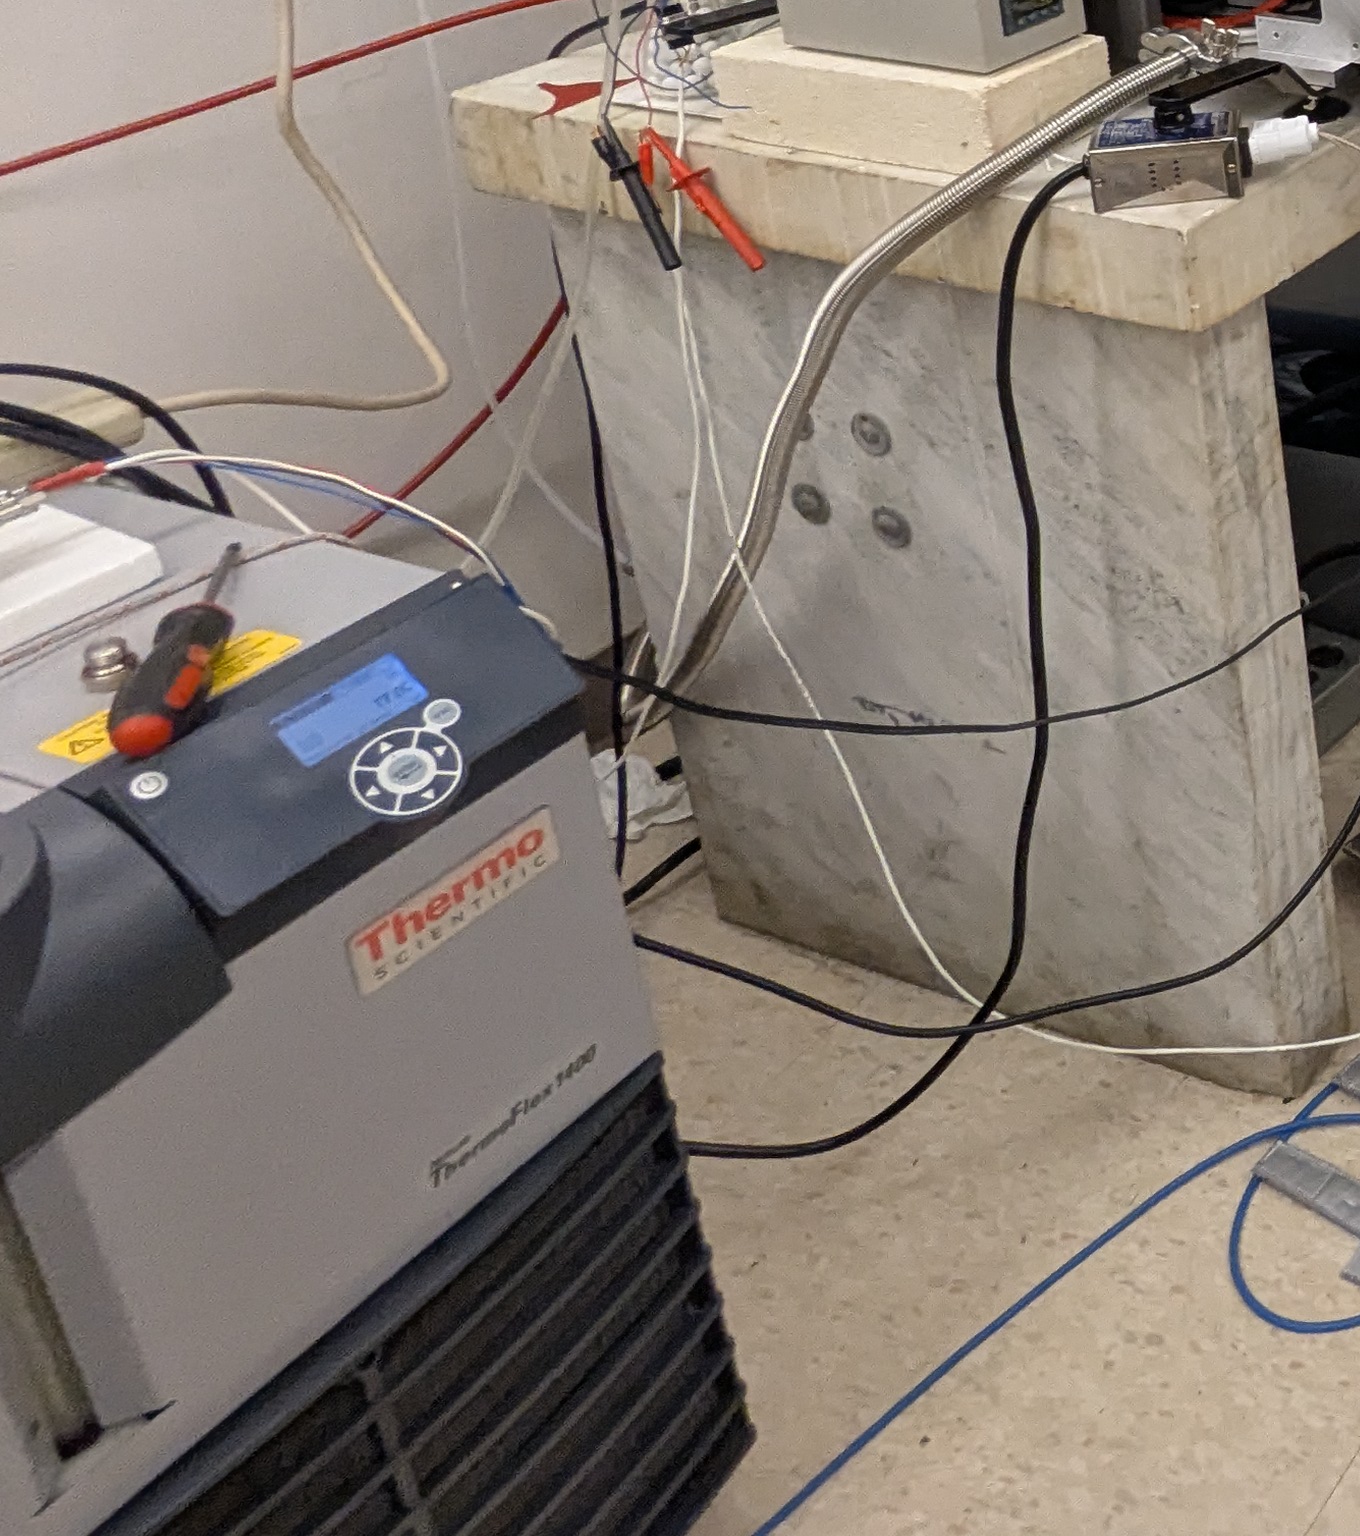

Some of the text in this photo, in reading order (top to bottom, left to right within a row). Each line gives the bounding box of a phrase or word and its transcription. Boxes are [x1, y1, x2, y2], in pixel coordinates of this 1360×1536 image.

[355, 829, 544, 962] Thermo
[374, 854, 547, 981] SCIENTIFIC
[431, 1043, 597, 1189] ThermoFlex 1400
